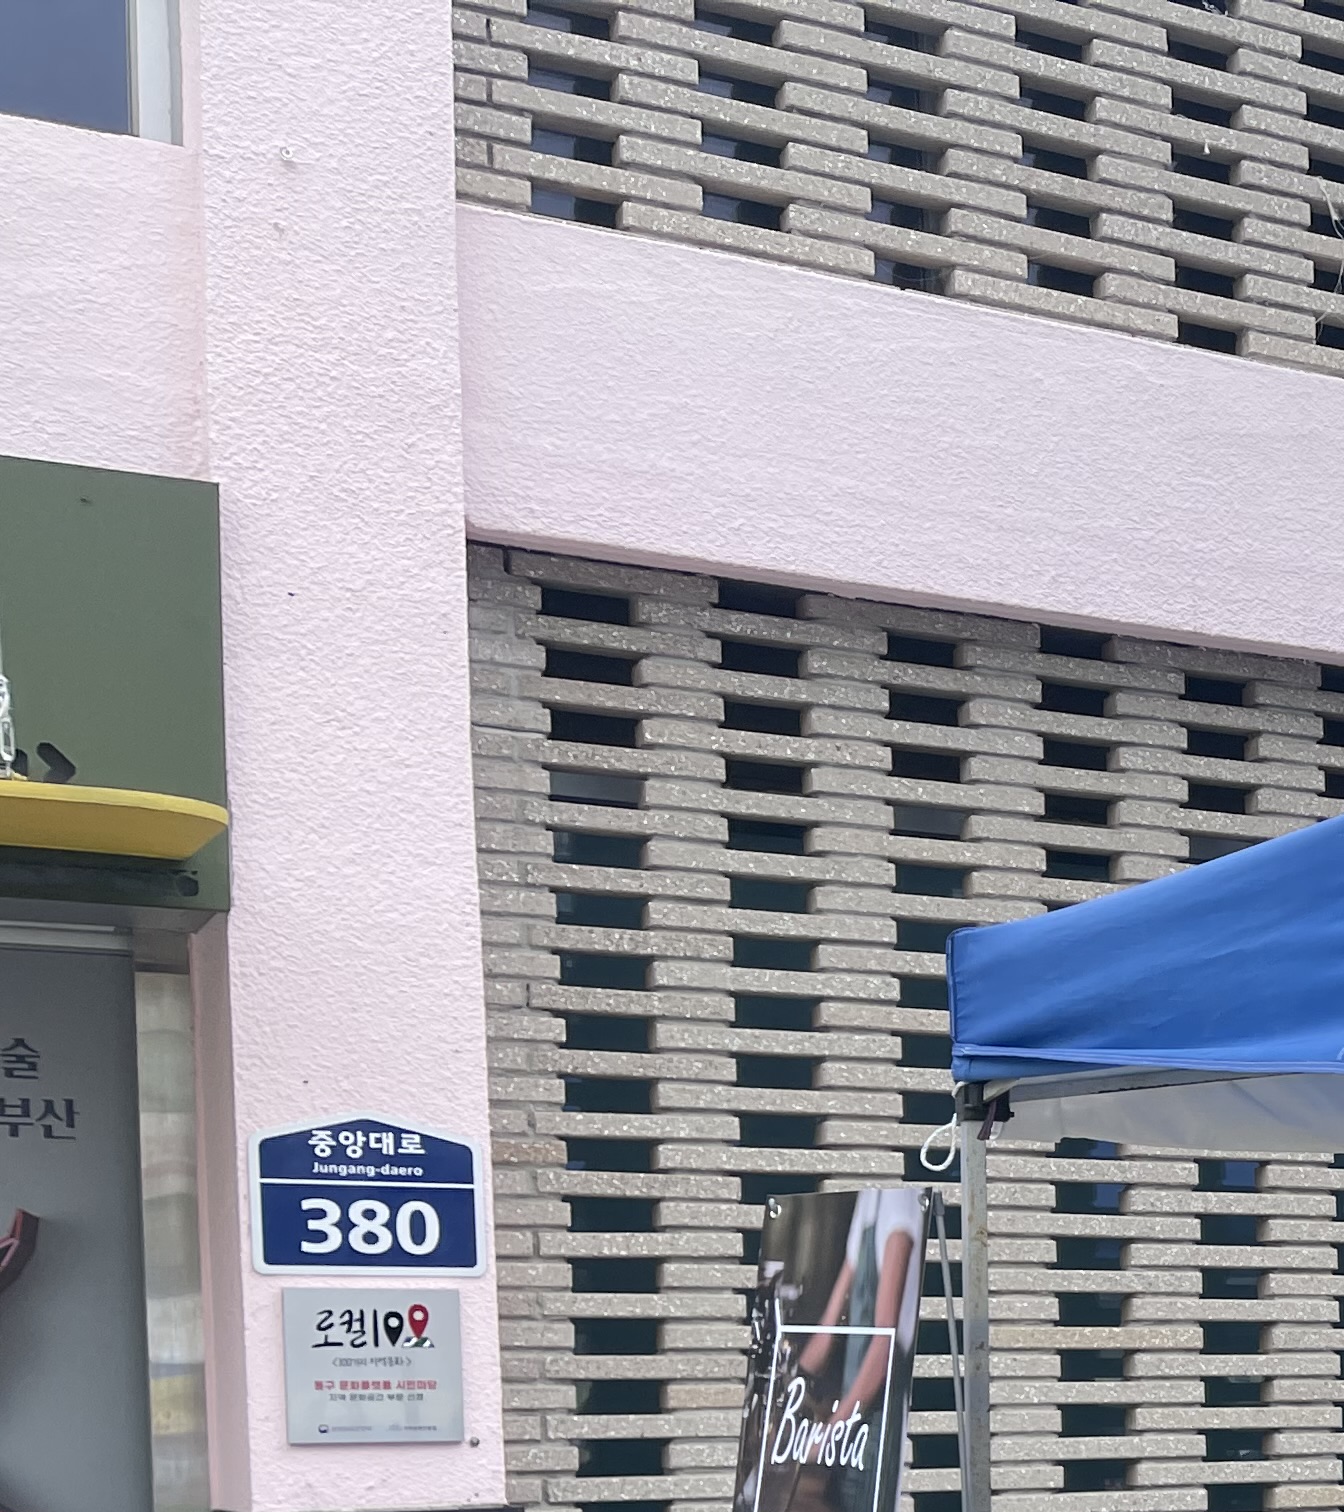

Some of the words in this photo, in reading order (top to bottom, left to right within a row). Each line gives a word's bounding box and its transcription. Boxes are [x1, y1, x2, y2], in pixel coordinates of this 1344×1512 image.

[0, 1098, 80, 1140] 부산
[307, 1129, 426, 1159] 중앙대로
[312, 1162, 424, 1177] Jungang-daero
[300, 1197, 440, 1256] 380
[771, 1377, 868, 1472] Barista
